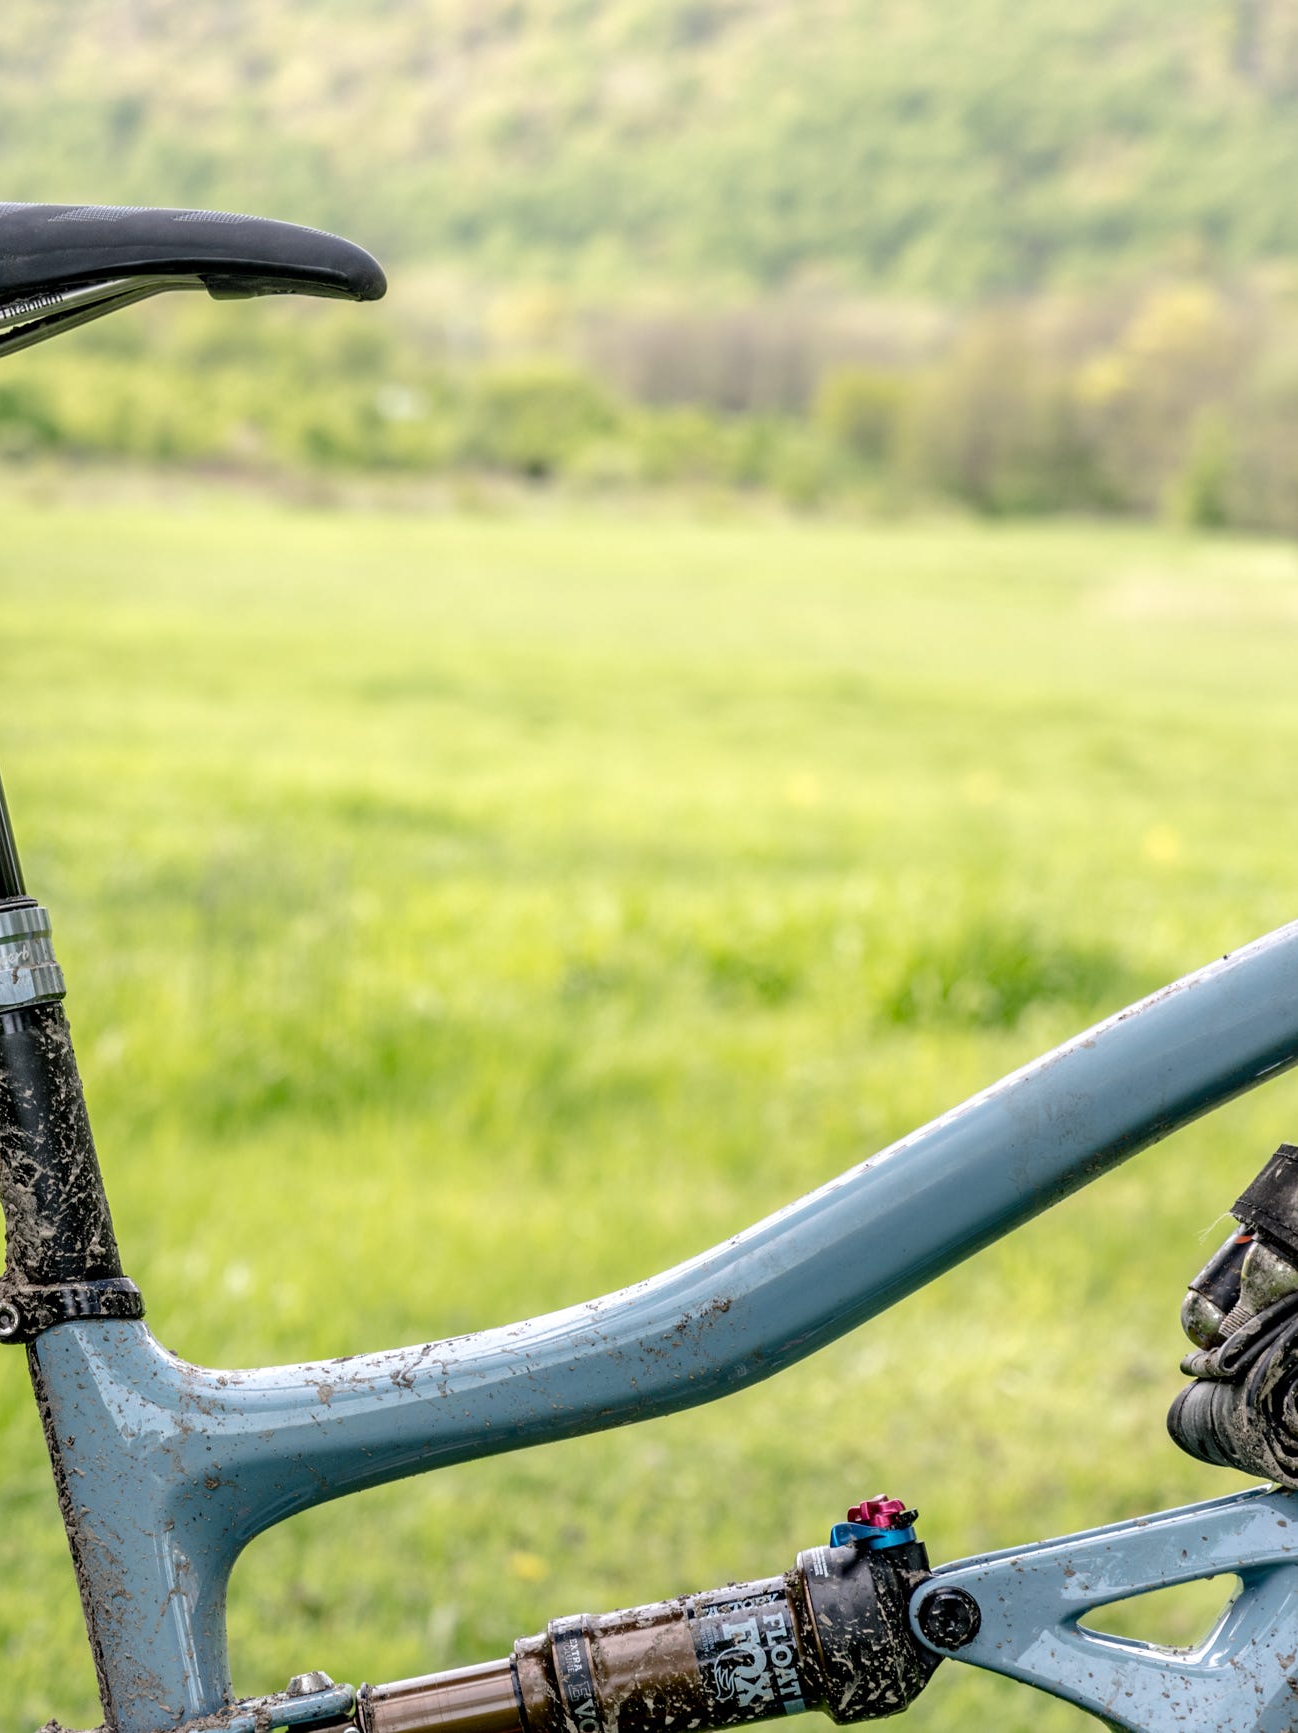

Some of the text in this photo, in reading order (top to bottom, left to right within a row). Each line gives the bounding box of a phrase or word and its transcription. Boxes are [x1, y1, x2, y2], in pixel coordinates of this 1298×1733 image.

[2, 293, 64, 319] Titanium
[569, 1638, 583, 1673] EXTRA
[714, 1617, 775, 1707] FOX
[763, 1612, 802, 1696] FLOAT
